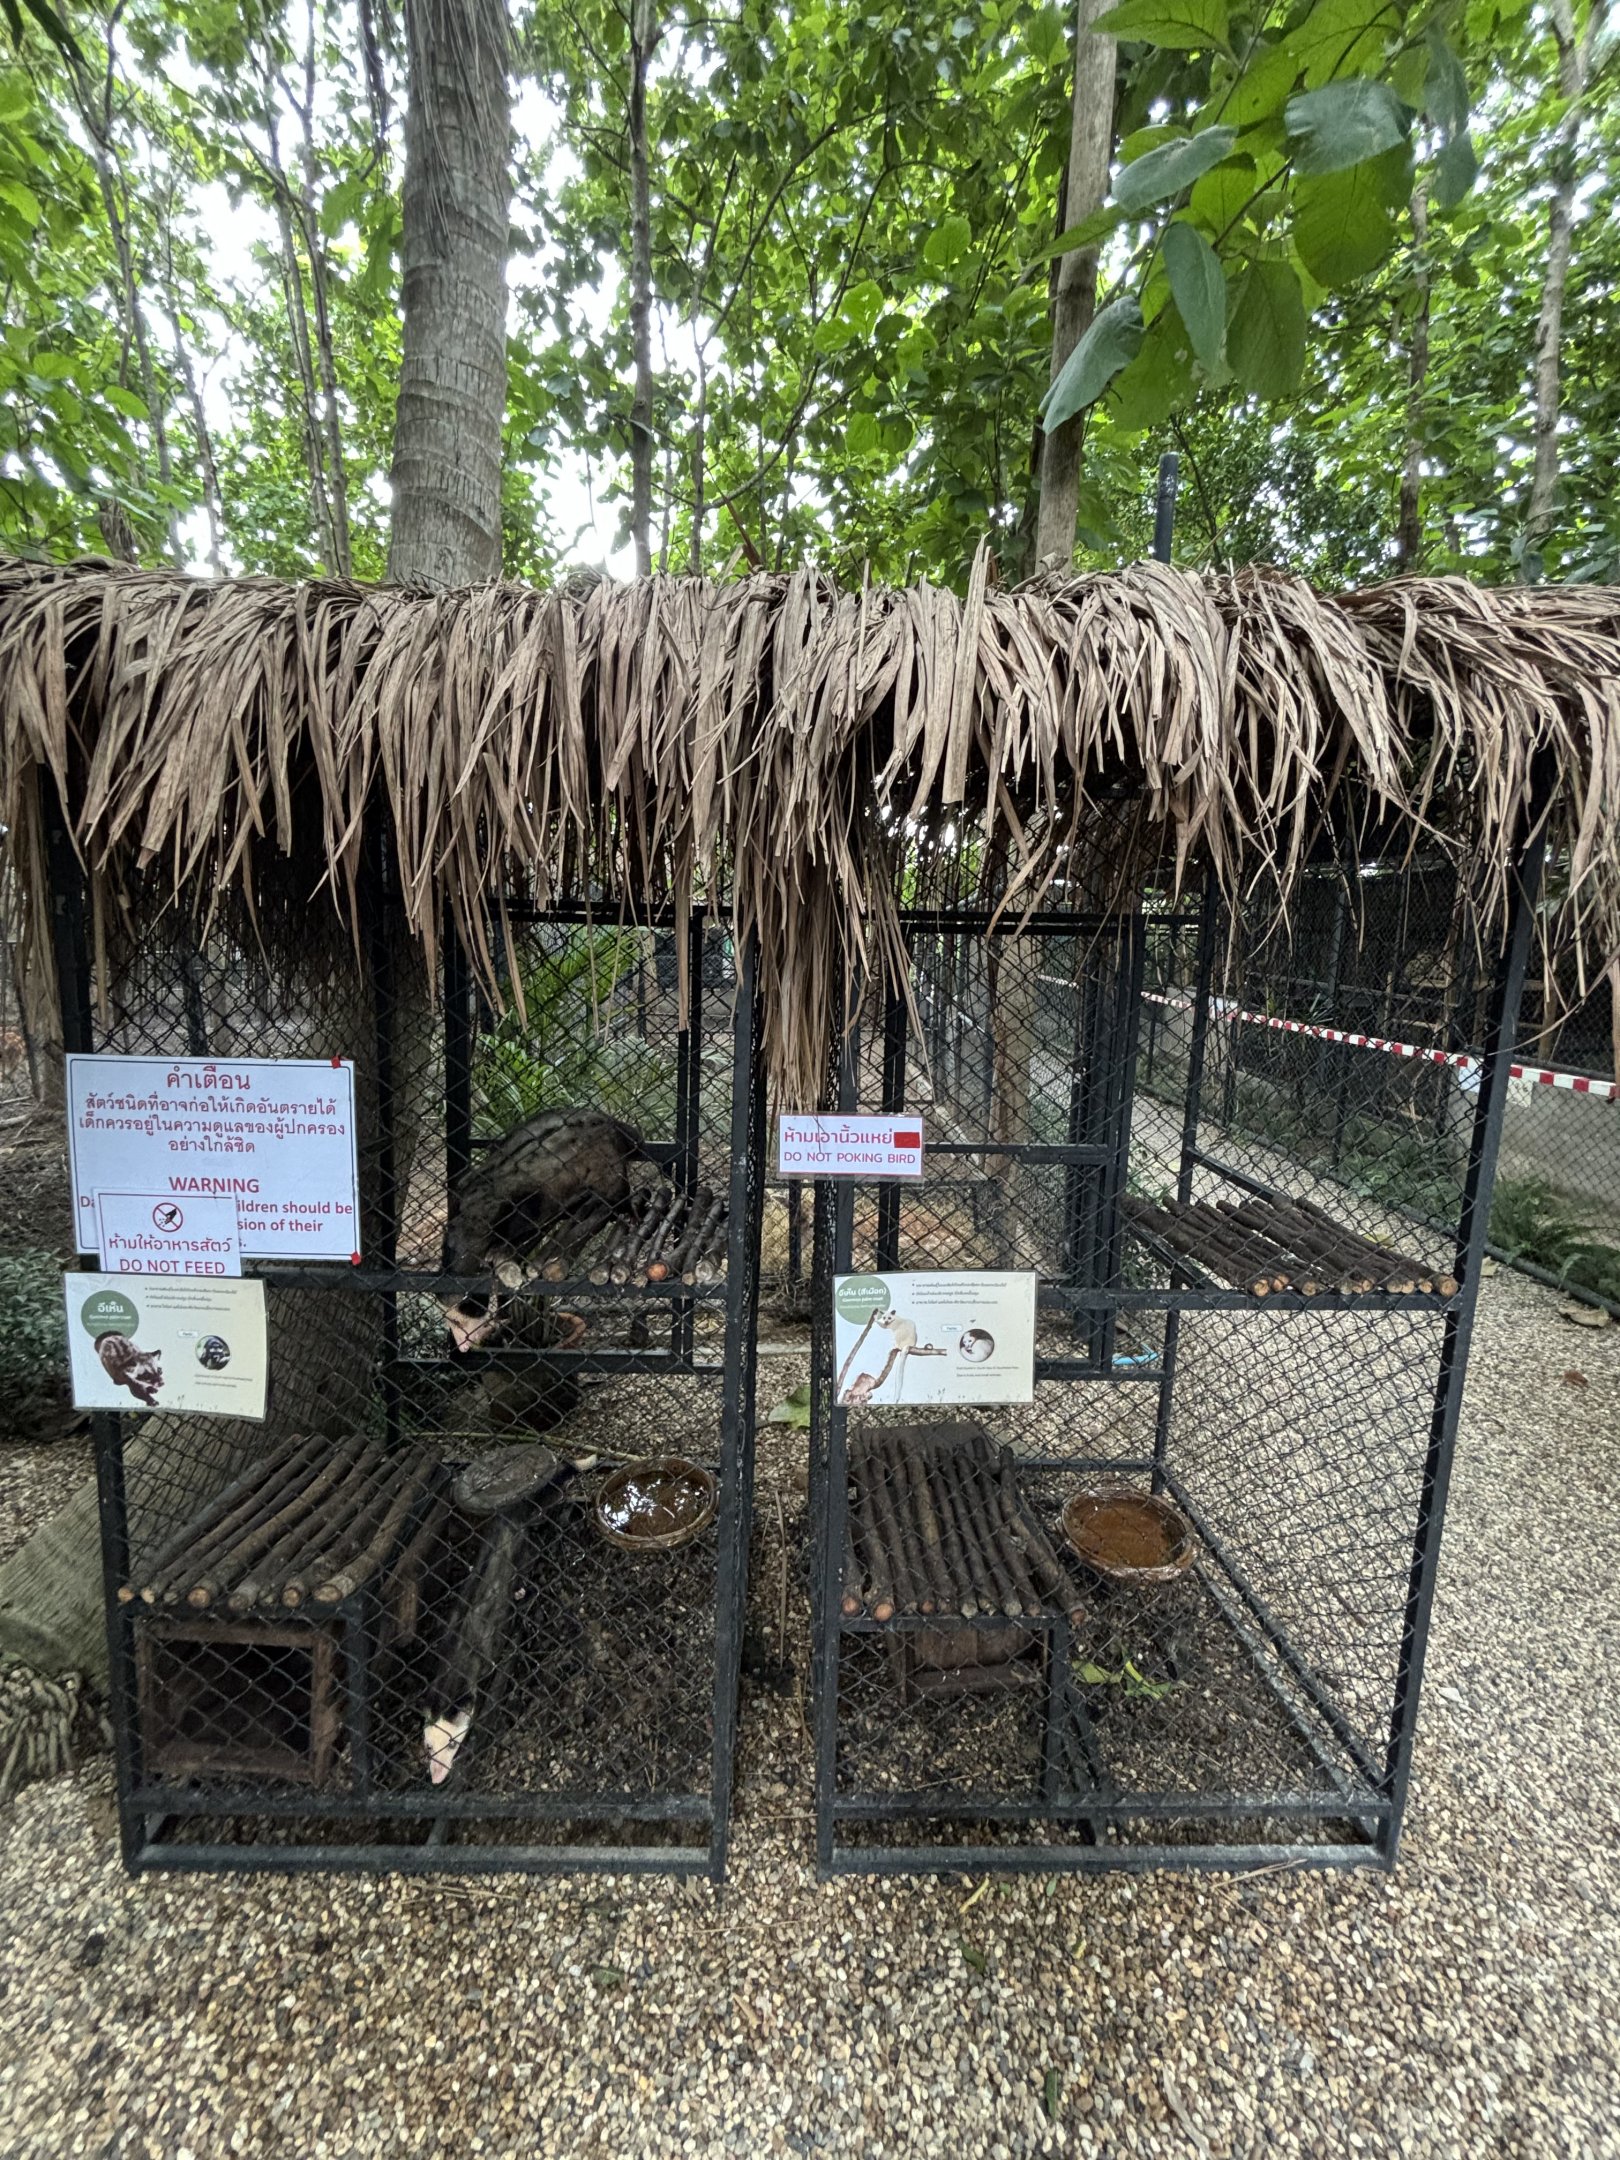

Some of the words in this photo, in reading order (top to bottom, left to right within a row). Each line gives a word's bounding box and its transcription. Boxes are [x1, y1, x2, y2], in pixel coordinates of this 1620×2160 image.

[166, 1065, 251, 1090] คำเตือน
[86, 1091, 337, 1115] สัตว์ชนิดที่อาจก่อให้เกิดอันตรายได้
[79, 1111, 345, 1139] เด็กควรอยู่ในความดูแลของผู้ปกครอง
[168, 1135, 255, 1153] อย่างใกล้ชิด
[784, 1152, 802, 1161] DO
[807, 1152, 832, 1162] NOT
[837, 1153, 883, 1163] POKING
[887, 1154, 916, 1163] BIRD
[169, 1177, 260, 1193] WARNING
[237, 1200, 278, 1213] ildren
[282, 1201, 331, 1214] should
[335, 1202, 353, 1214] be
[270, 1219, 286, 1231] of
[288, 1219, 324, 1232] their
[109, 1233, 233, 1252] ห้ามให้อาหารสัตว์
[119, 1259, 142, 1272] DO
[147, 1260, 179, 1273] NOT
[185, 1261, 225, 1274] FEED
